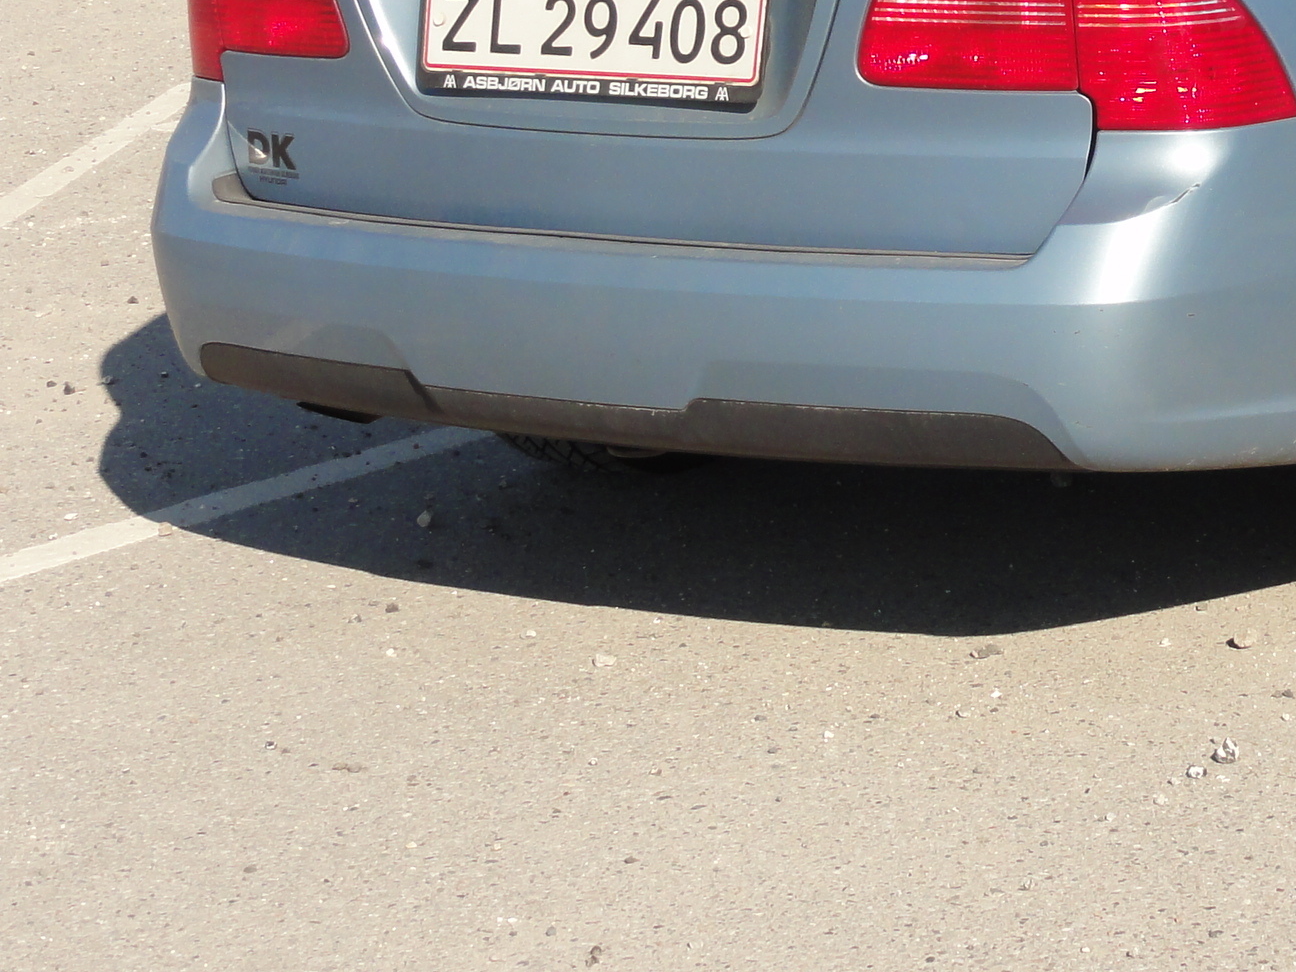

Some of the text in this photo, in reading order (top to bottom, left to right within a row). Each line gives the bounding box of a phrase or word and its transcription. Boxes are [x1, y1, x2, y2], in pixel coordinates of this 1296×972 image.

[463, 75, 546, 92] ASBJØRN
[551, 79, 600, 95] AUTO
[608, 81, 709, 100] SILKEBORG
[247, 128, 297, 170] DK
